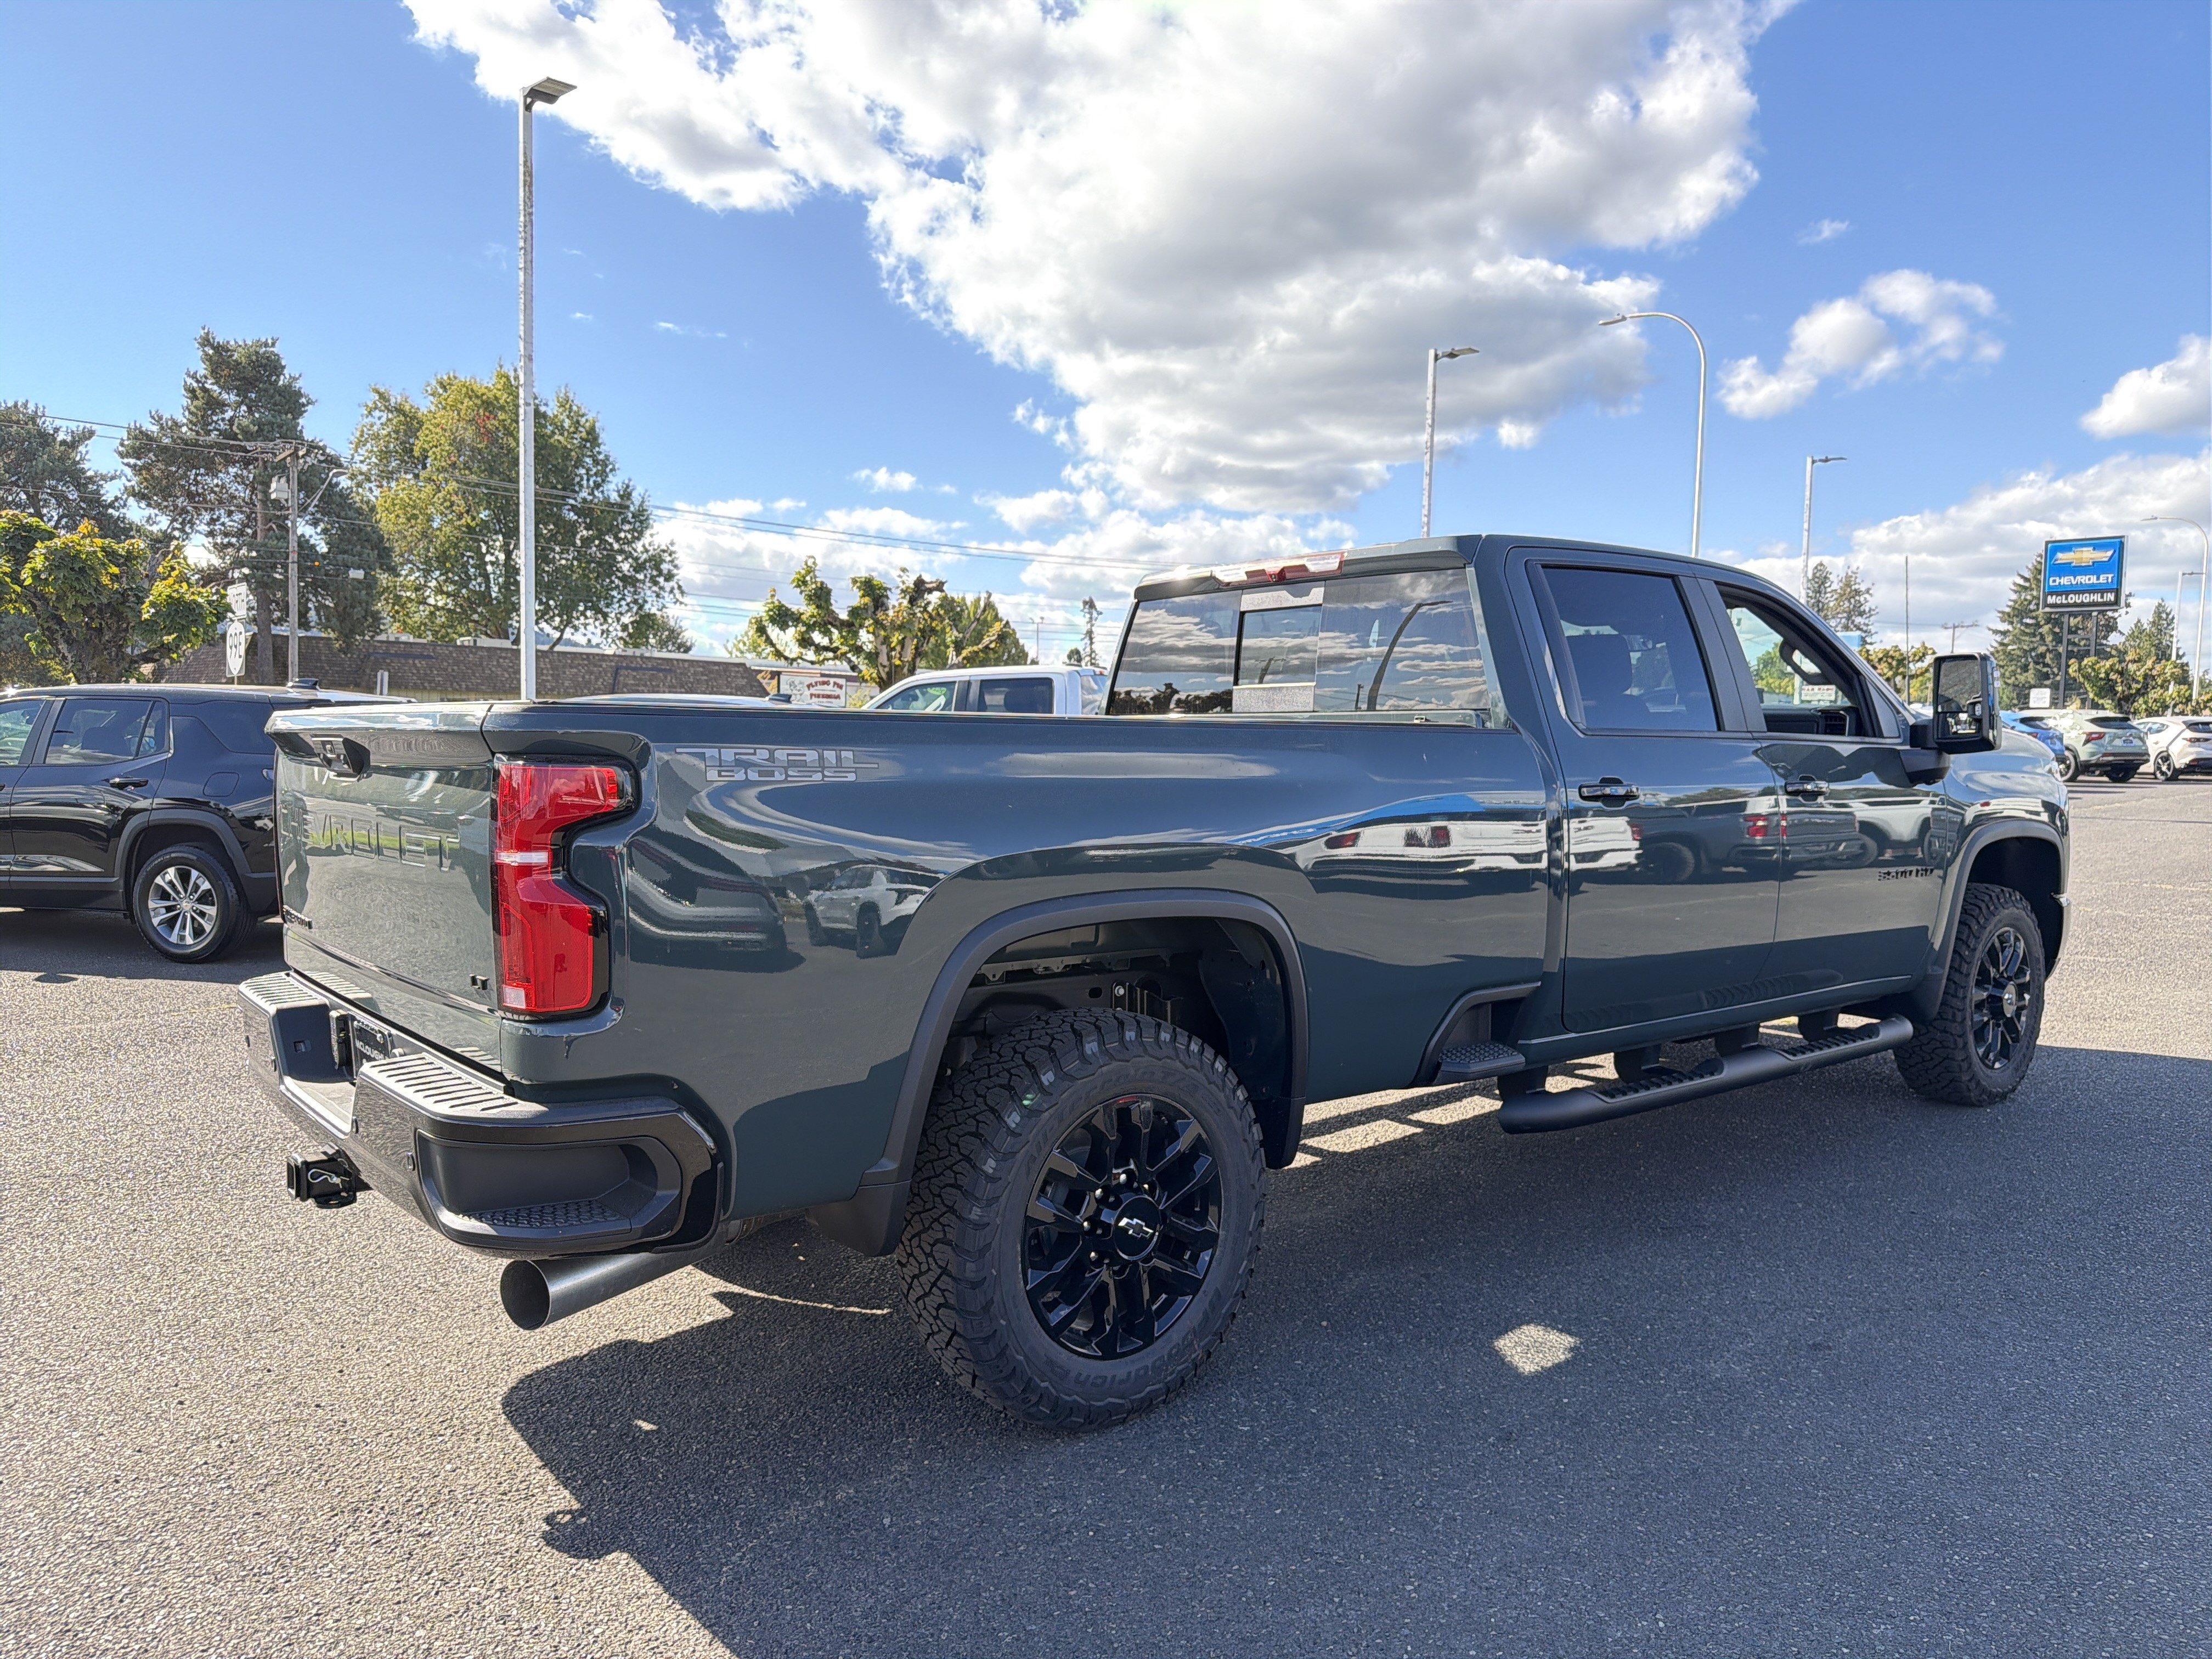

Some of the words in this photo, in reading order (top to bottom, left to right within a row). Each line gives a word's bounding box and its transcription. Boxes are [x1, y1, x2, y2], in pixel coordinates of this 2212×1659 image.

[2049, 574, 2114, 586] CHEVROLET
[2047, 592, 2115, 604] McLOUGHLIN
[229, 631, 242, 659] 99E
[675, 747, 879, 769] TRAIL
[706, 767, 857, 782] BOSS
